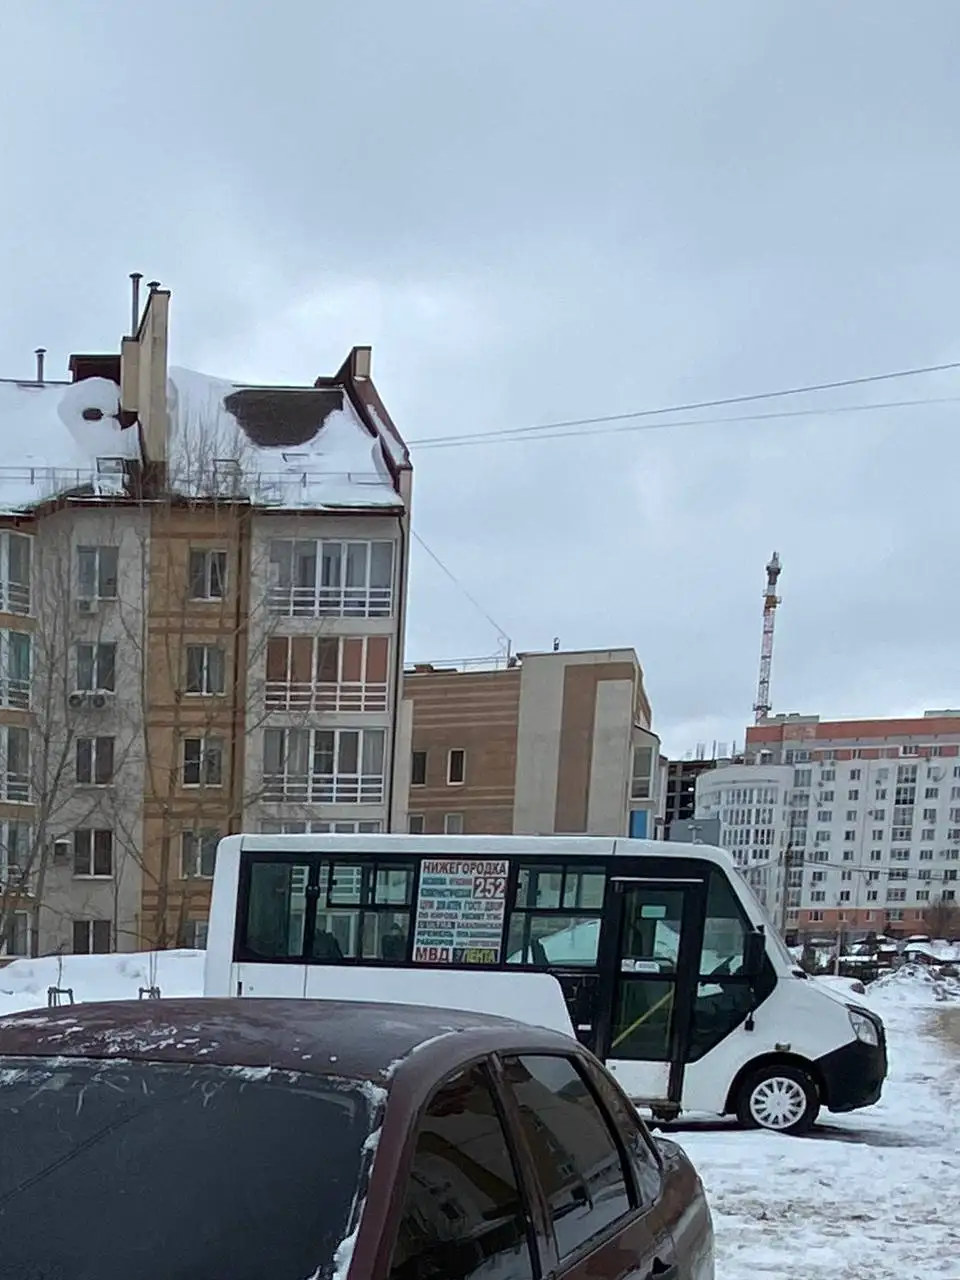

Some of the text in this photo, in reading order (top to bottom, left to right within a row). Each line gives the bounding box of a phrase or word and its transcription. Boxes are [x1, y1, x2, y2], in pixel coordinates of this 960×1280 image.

[423, 862, 506, 876] НИЖЕГОРОДКА
[474, 878, 505, 898] 252
[416, 947, 449, 962] МВД
